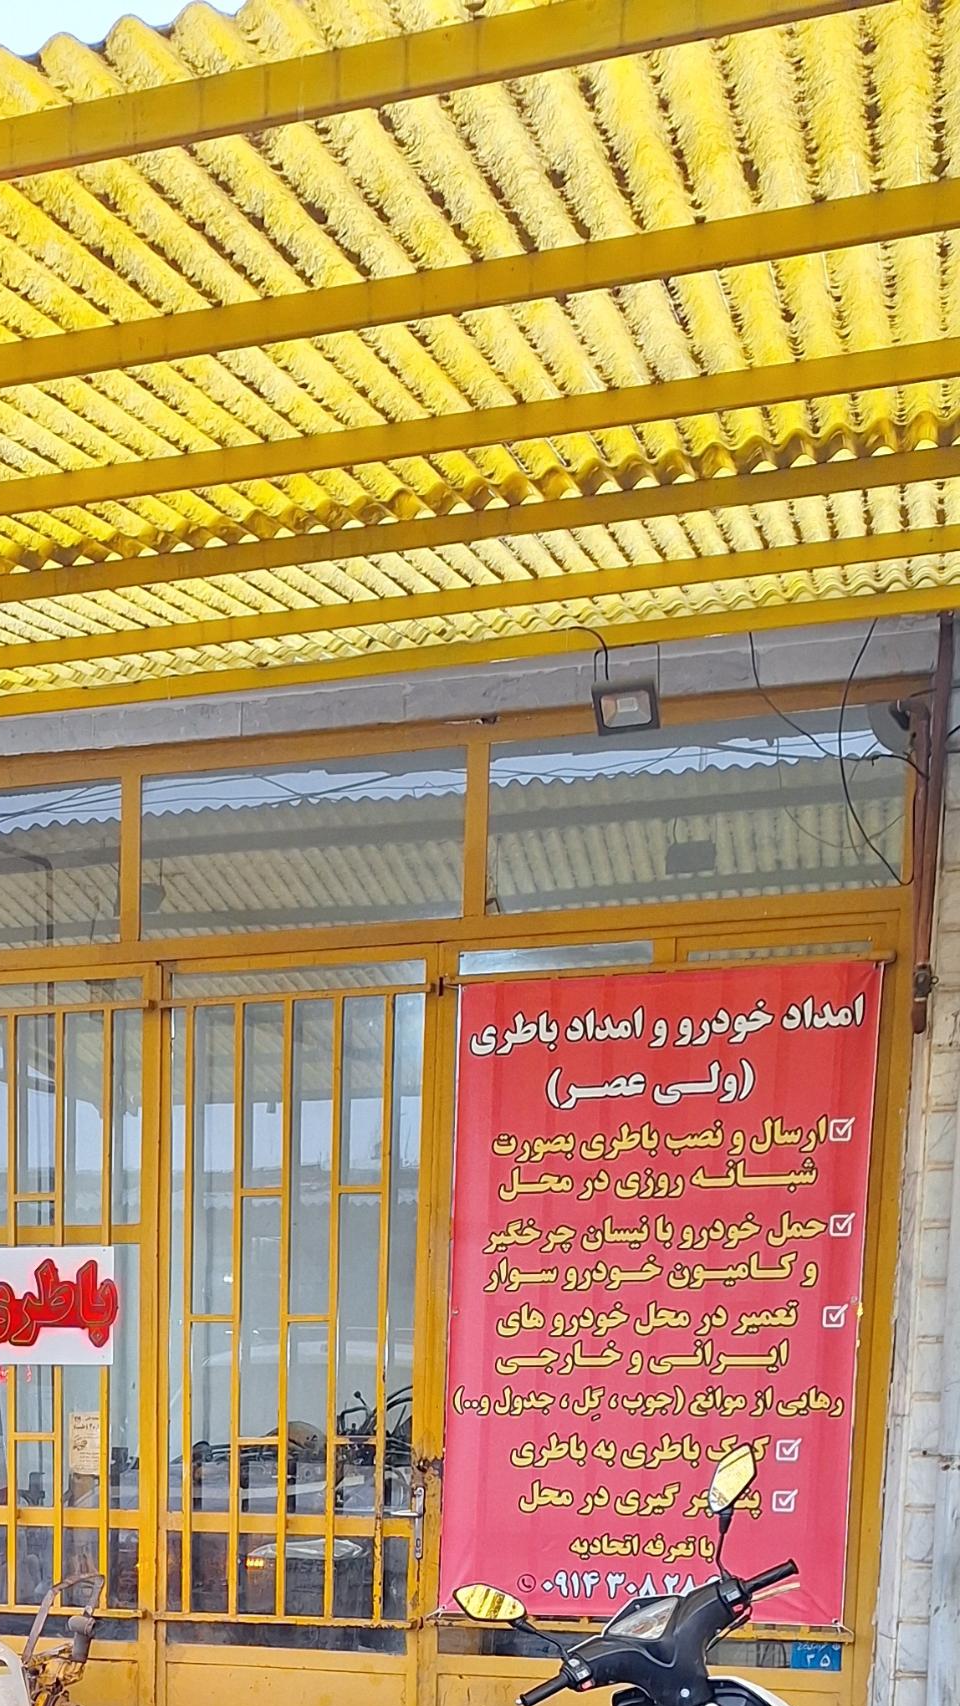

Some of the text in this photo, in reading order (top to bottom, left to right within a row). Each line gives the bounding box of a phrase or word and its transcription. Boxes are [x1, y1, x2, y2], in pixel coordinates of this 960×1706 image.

[470, 993, 866, 1056] امداد خودرو و امداد باطری
[546, 1058, 755, 1110] (ولی عصر)
[492, 1116, 827, 1163] ارسال و نصب باطری بصورت
[498, 1158, 817, 1201] شبانه روزی در محل
[581, 1215, 649, 1252] نیسان
[655, 1214, 674, 1249] با
[678, 1212, 761, 1250] خودرو
[767, 1212, 827, 1247] حمل
[483, 1252, 818, 1292] و کامیون خودرو سوار
[496, 1301, 799, 1338] تعمیر در محل خودرو های
[495, 1339, 789, 1375] ایرانی و خارجی
[493, 1385, 555, 1416] جدول
[689, 1386, 747, 1418] موانع
[750, 1386, 773, 1417] از
[776, 1386, 844, 1417] رهایی
[510, 1433, 772, 1469] کک باطری به باطری
[517, 1480, 574, 1513] محل
[578, 1486, 610, 1515] در
[614, 1482, 681, 1516] گیری
[569, 1533, 715, 1563] با تعرفه اتحادیه
[541, 1570, 601, 1599] ۰۹۱۴
